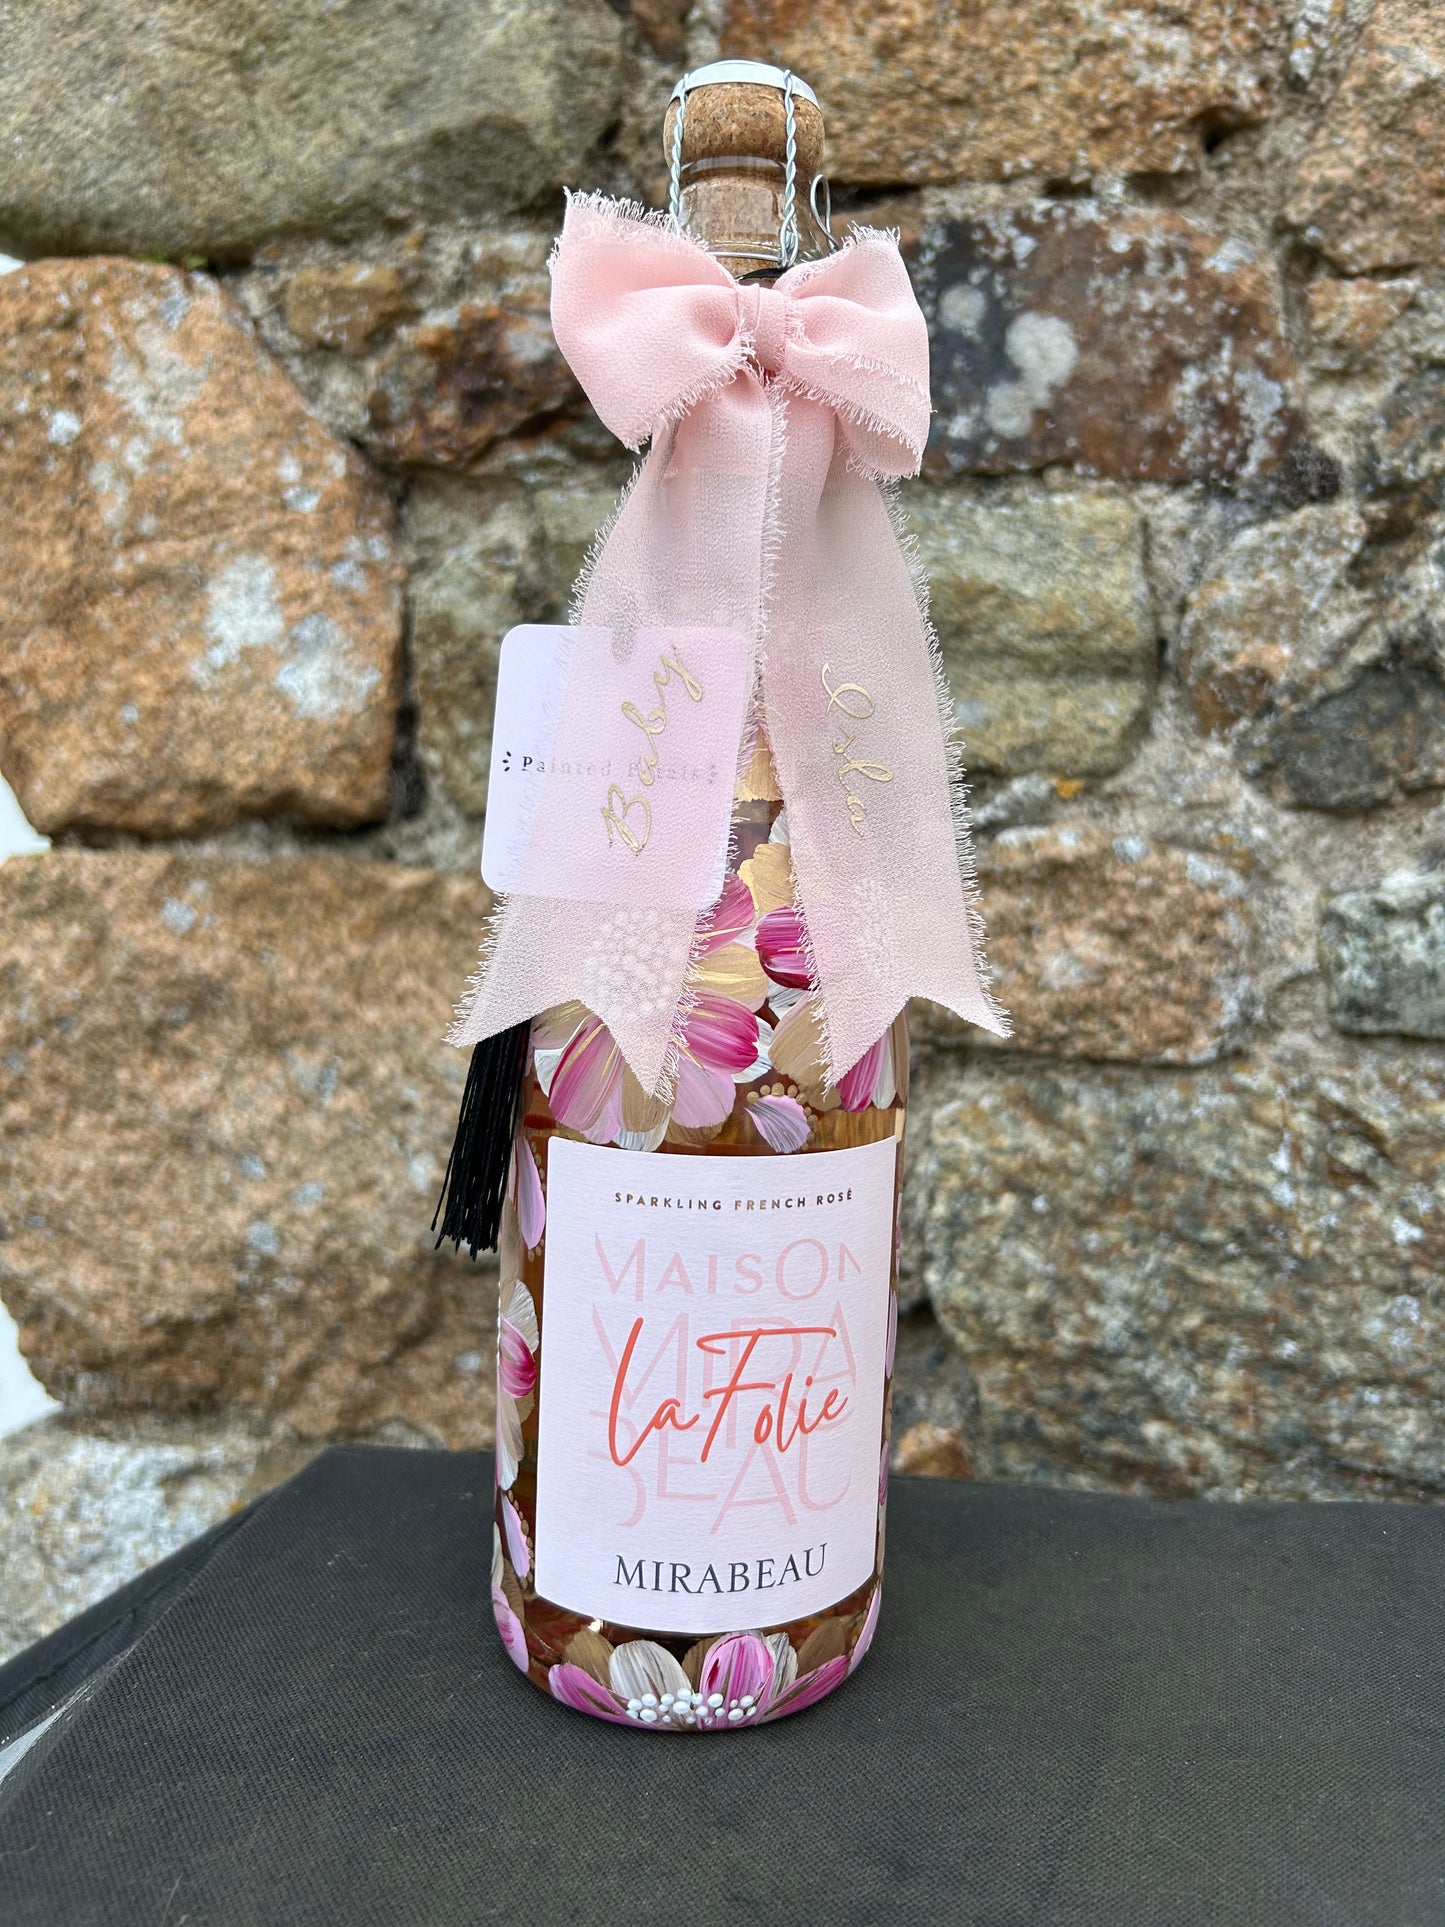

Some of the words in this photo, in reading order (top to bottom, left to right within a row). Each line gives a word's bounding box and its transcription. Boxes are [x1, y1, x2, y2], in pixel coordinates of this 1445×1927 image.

[520, 755, 613, 778] Painted
[601, 643, 703, 857] Baby
[614, 1191, 723, 1212] SPARKLING
[733, 1196, 807, 1212] FRENCH
[815, 1186, 853, 1206] ROSÉ
[608, 1316, 700, 1467] La
[696, 1327, 849, 1463] Folie
[612, 1542, 829, 1595] MIRABEAU
